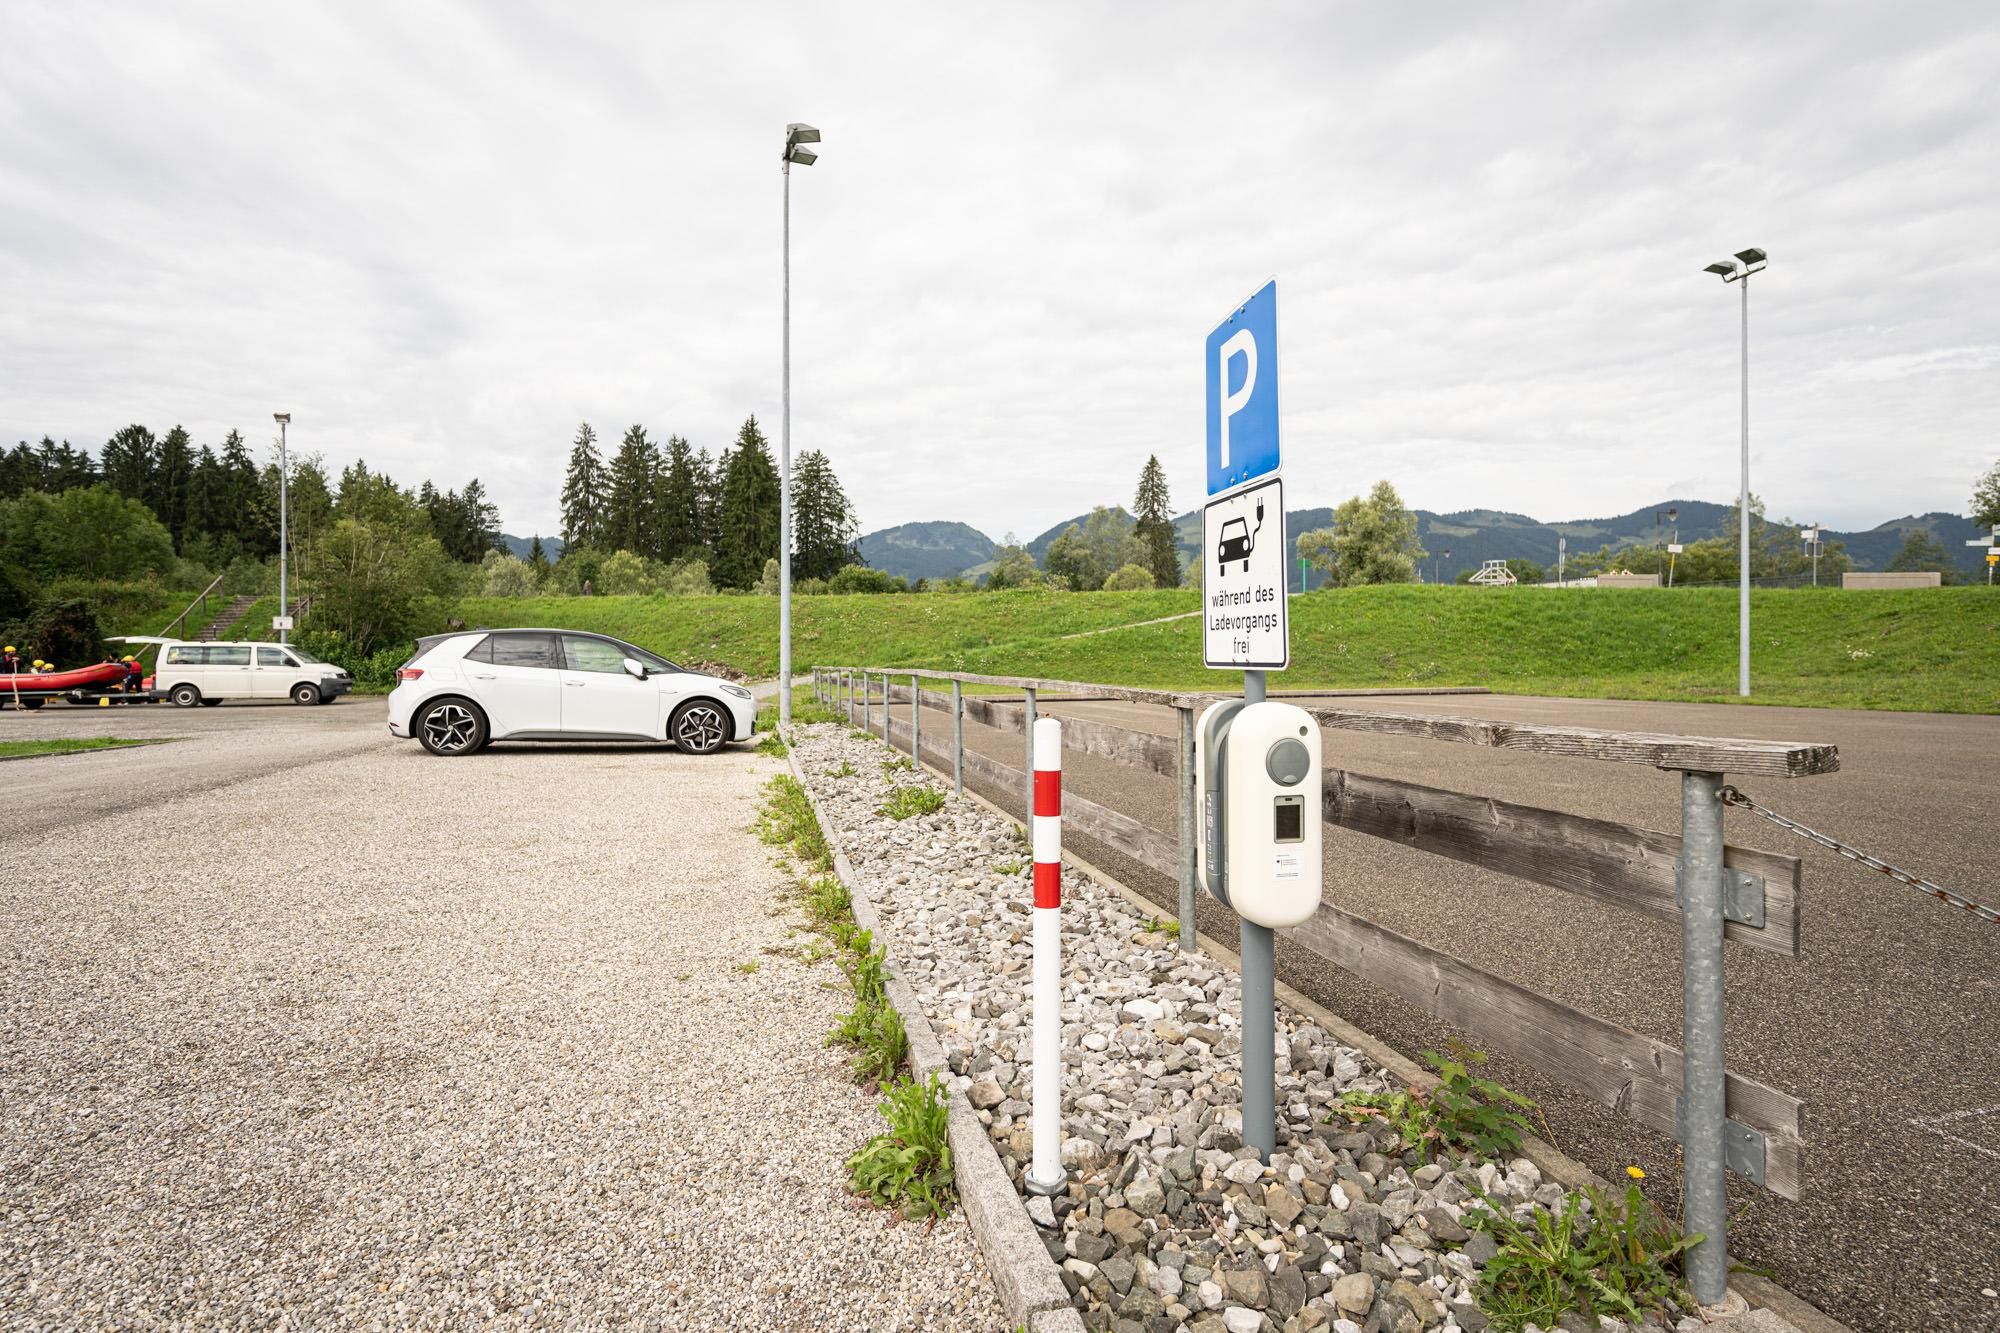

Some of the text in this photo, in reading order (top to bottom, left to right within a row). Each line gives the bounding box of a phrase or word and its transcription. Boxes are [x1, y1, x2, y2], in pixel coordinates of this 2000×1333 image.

[1220, 328, 1258, 469] P
[1211, 585, 1274, 607] während des
[1210, 613, 1278, 634] Ladevorgangs
[1233, 636, 1250, 654] frei
